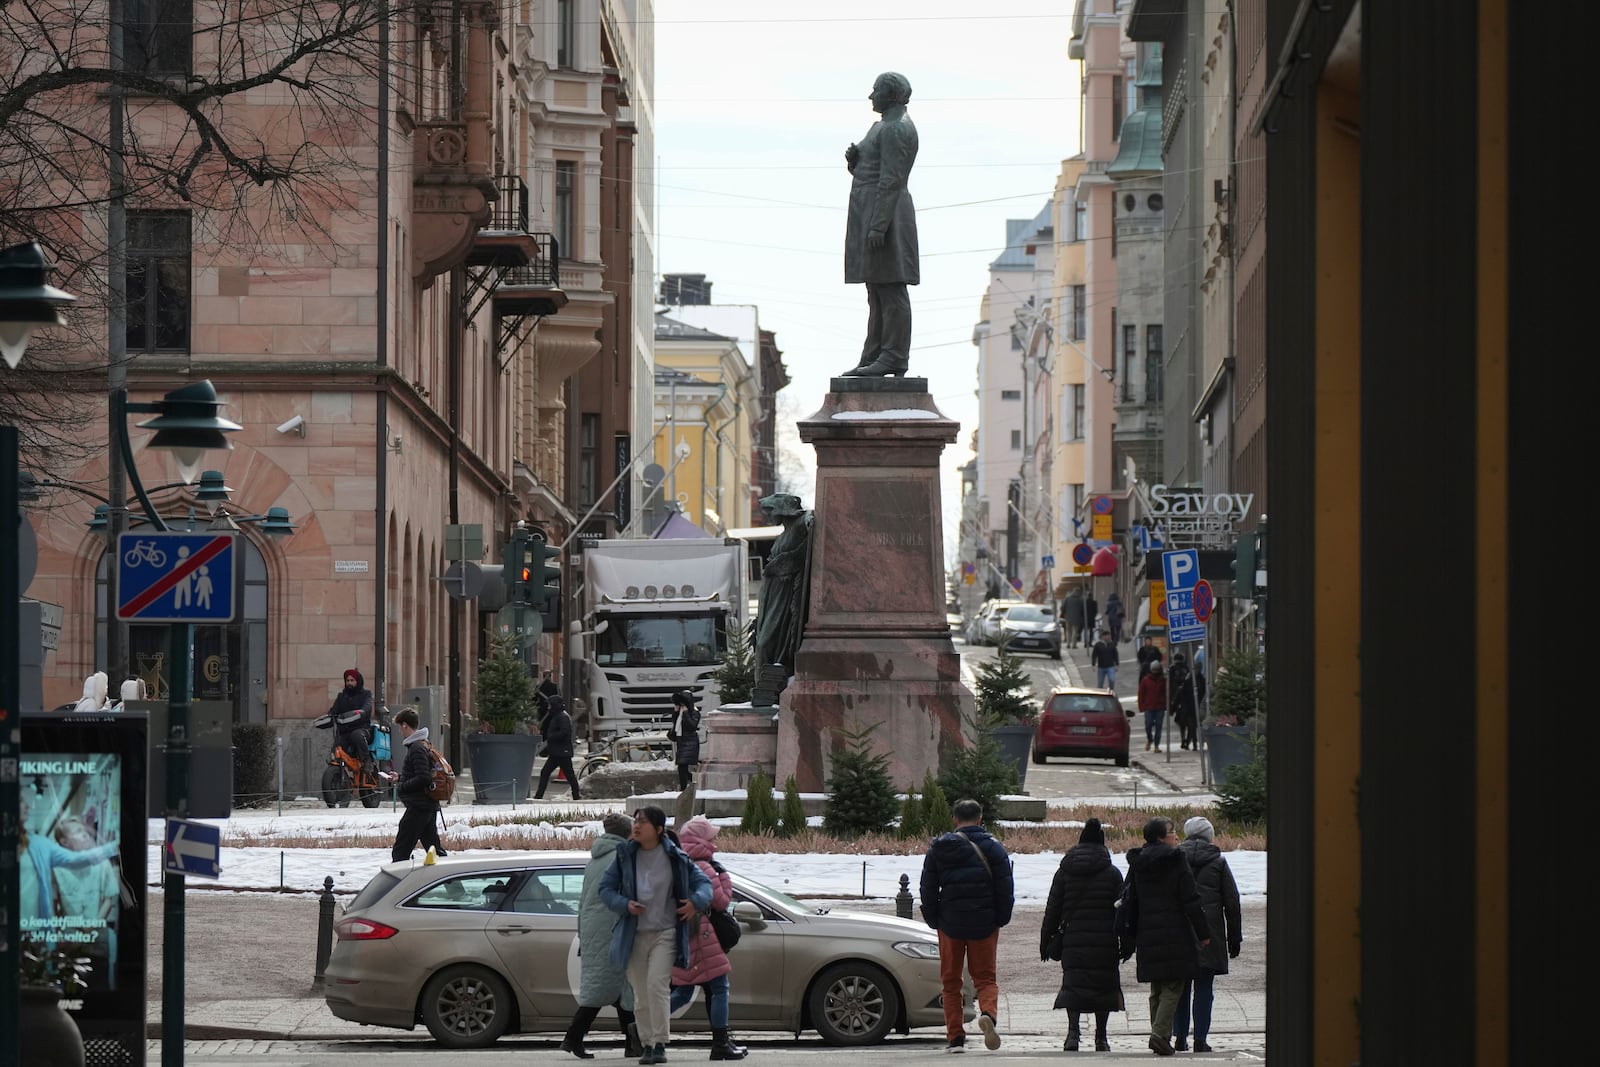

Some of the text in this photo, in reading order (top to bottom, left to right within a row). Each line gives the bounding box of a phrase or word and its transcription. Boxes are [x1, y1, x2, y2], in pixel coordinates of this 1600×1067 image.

[1151, 484, 1254, 522] Savoy
[1170, 553, 1193, 588] P
[65, 762, 96, 774] LINE
